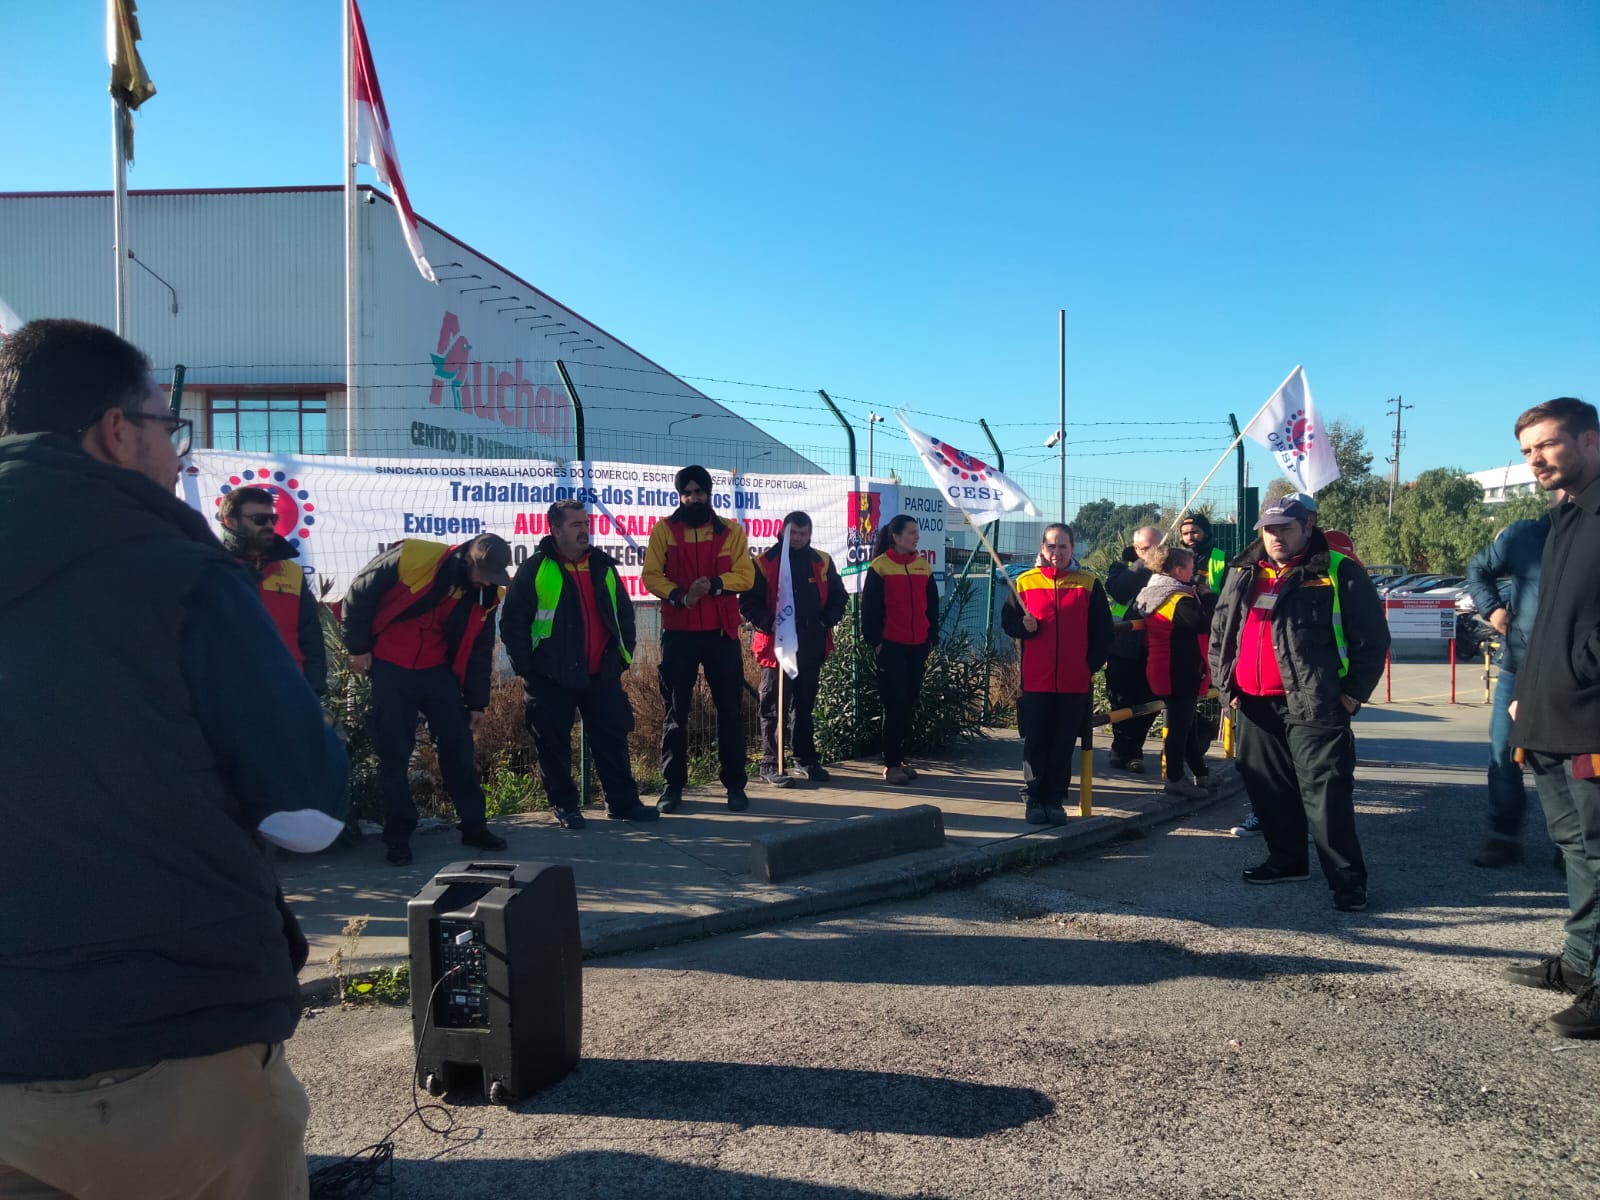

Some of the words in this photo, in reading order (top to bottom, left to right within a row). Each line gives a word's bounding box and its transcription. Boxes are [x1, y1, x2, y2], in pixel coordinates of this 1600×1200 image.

[429, 311, 570, 444] Auchan
[411, 421, 457, 453] CENTRO
[460, 433, 474, 457] DE
[375, 466, 438, 476] SINDICATO
[441, 467, 466, 476] DOS
[469, 467, 568, 478] TRABALHADORES
[570, 468, 585, 478] DO
[643, 471, 675, 483] ESCRIT
[711, 475, 750, 488] SERVIÇOS
[753, 478, 763, 488] DE
[765, 480, 808, 490] PORTUGAL
[450, 481, 598, 504] Trabalhadores
[602, 485, 632, 505] dos
[734, 491, 761, 510] DHL
[904, 497, 943, 513] PARQUE
[948, 486, 1004, 501] CESP
[404, 513, 486, 536] Exigem:
[742, 518, 783, 537] TODO
